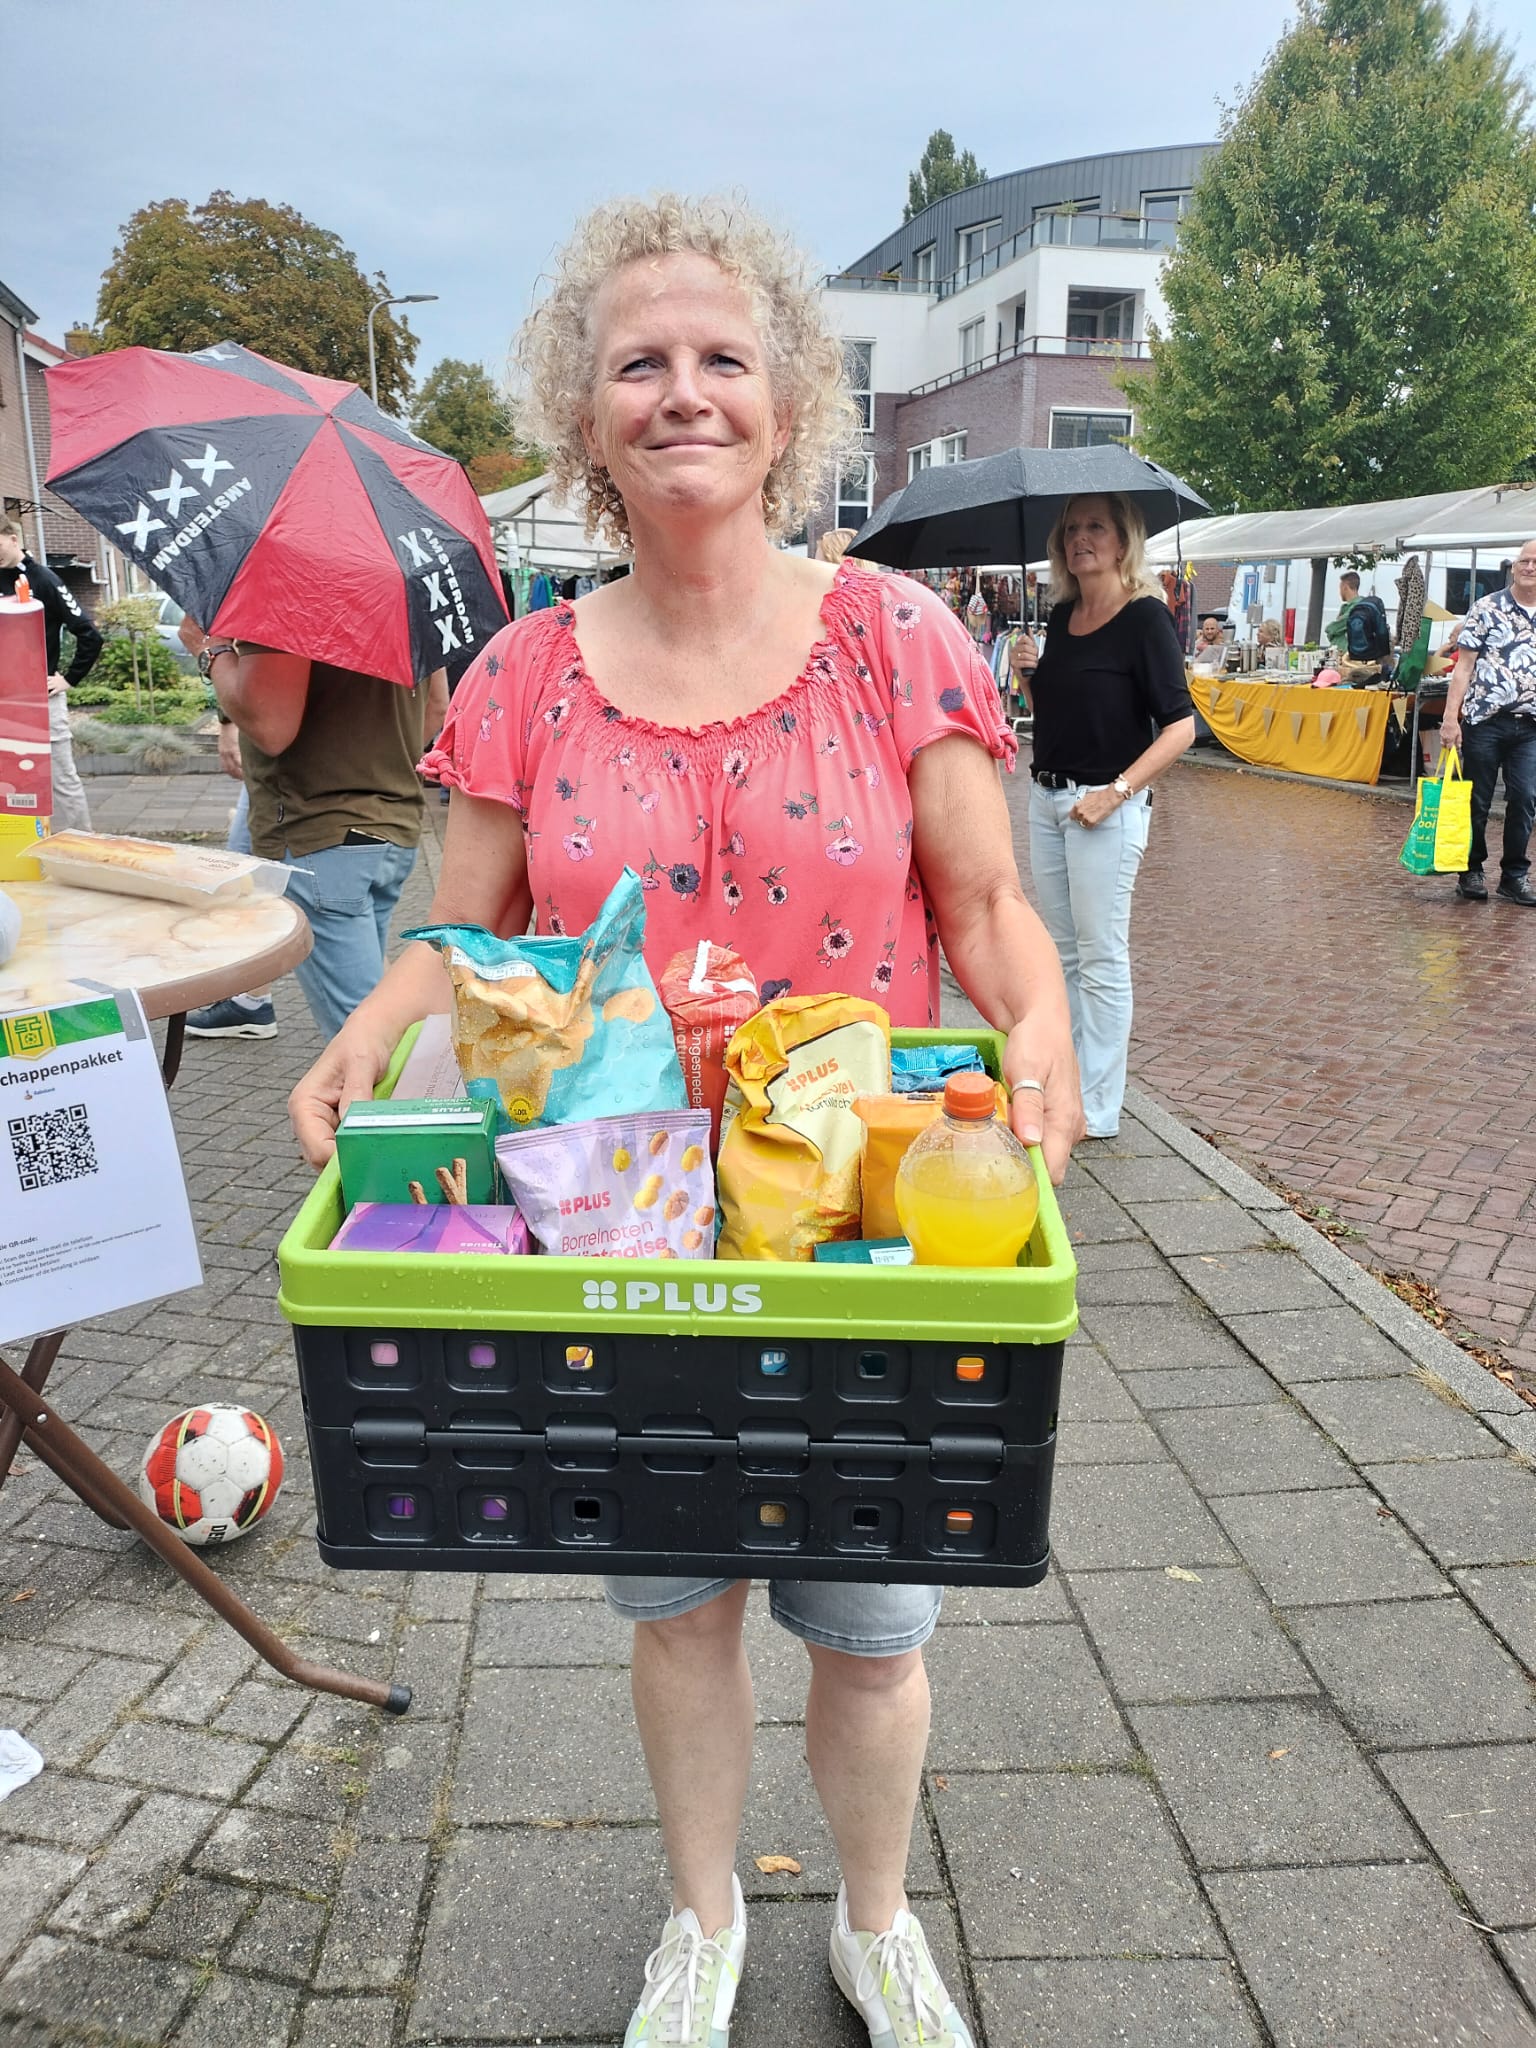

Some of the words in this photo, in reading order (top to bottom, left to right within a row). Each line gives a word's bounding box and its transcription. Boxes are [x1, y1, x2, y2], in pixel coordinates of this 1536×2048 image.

[152, 477, 252, 571] AMSTERDAM
[420, 527, 475, 644] AMSTERDAM
[0, 1050, 123, 1086] chappenpakket
[797, 1057, 839, 1087] PLUS
[573, 1191, 611, 1214] PLUS
[8, 1236, 38, 1248] QR-code:
[562, 1220, 653, 1252] Borrelnoten
[625, 1281, 763, 1314] PLUS
